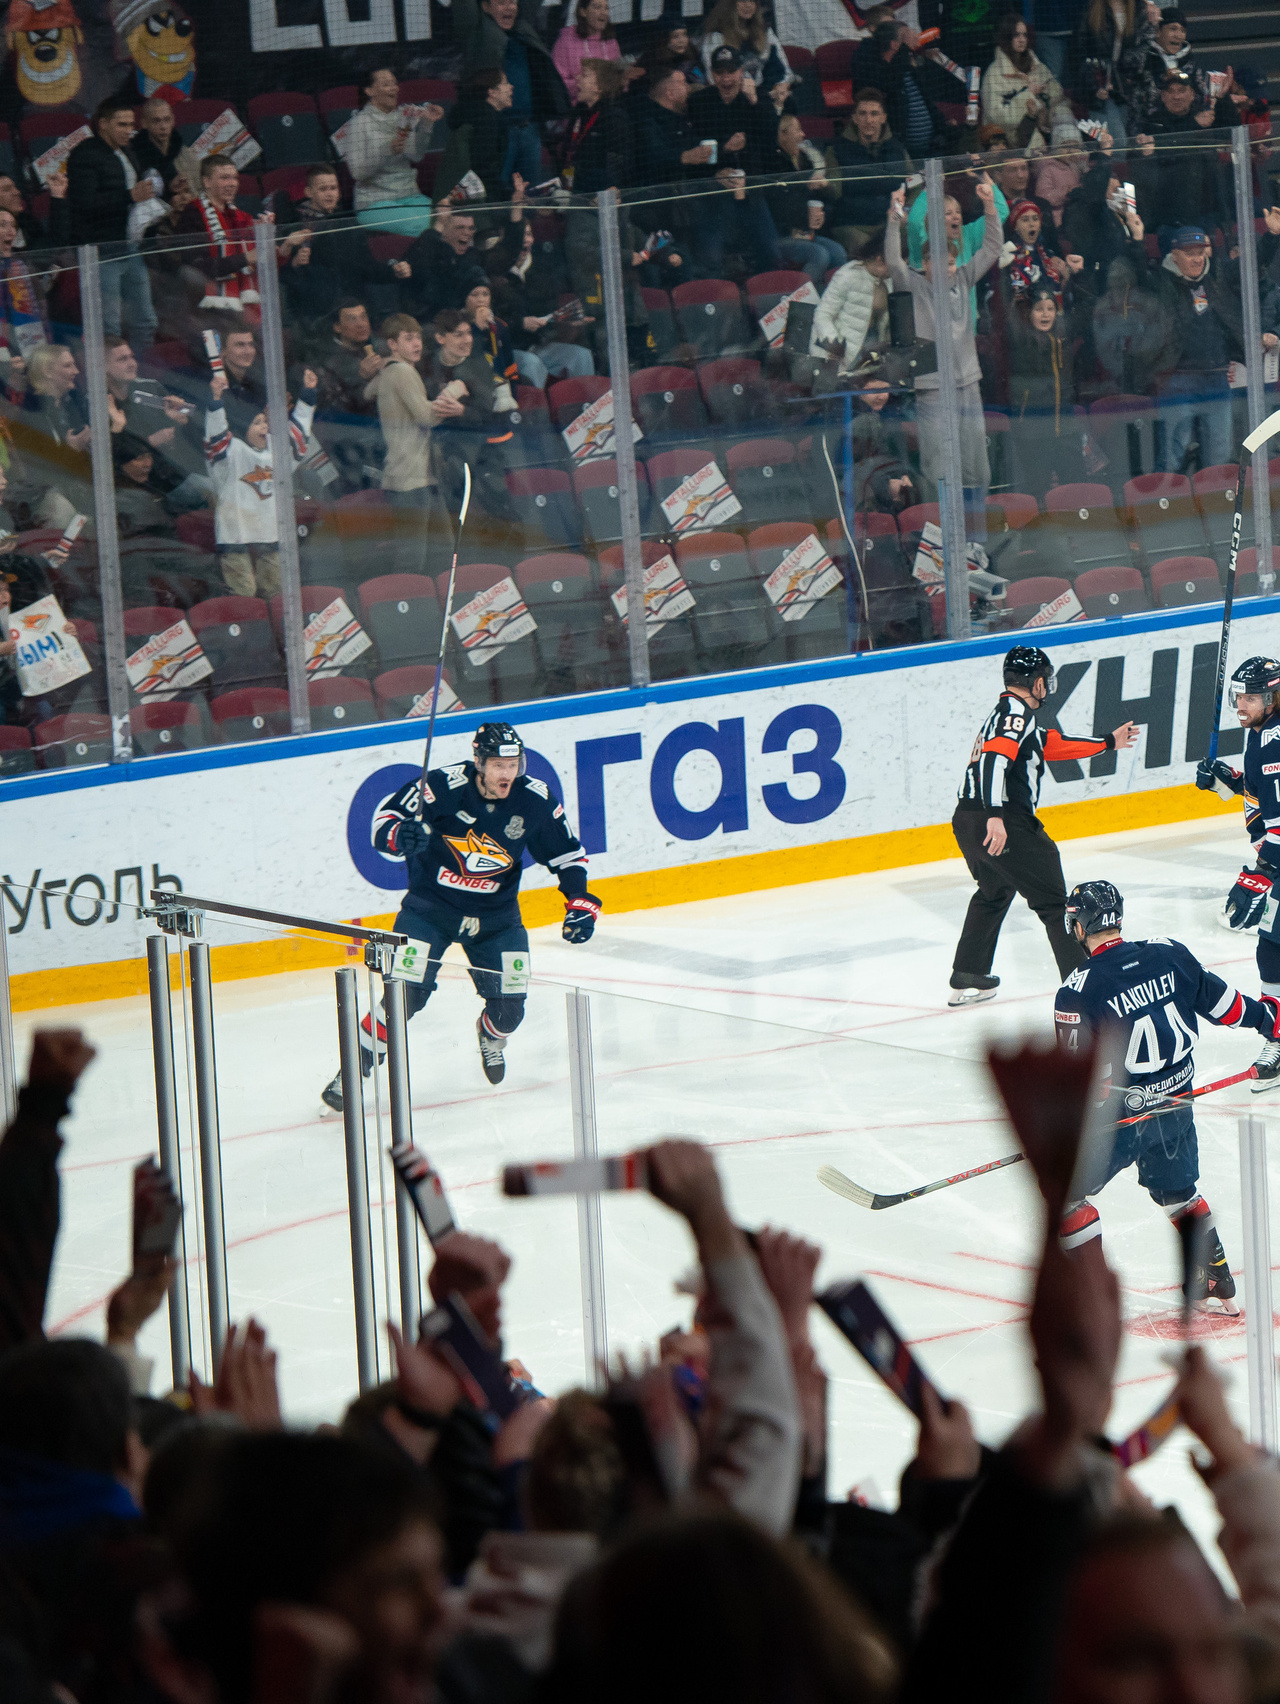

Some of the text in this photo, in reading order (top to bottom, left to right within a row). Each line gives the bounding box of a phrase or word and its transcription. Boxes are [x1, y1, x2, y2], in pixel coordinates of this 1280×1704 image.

[1229, 512, 1242, 572] CCM
[1003, 715, 1025, 732] 18
[439, 869, 500, 893] FONBET
[1236, 875, 1268, 892] CCM
[1101, 912, 1116, 927] 44
[1106, 970, 1177, 1019] YAKOVLEV
[1124, 1001, 1200, 1075] 44
[945, 1159, 1003, 1184] VAPOR
